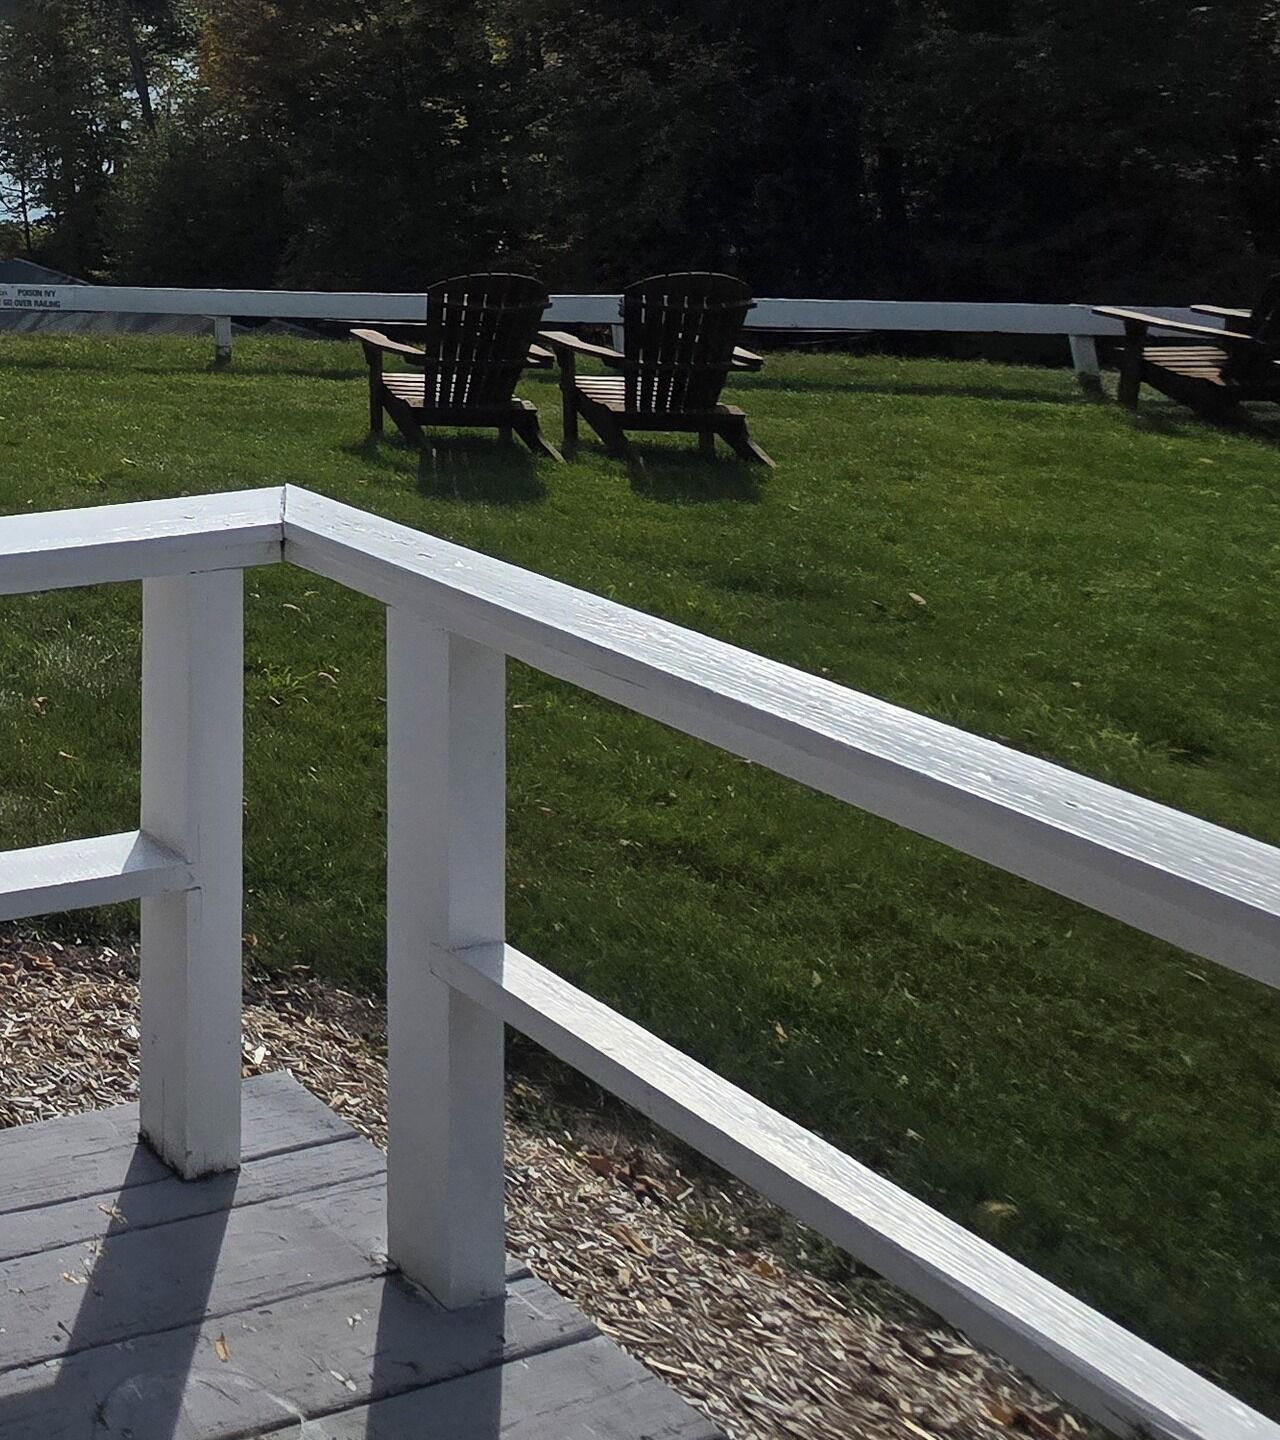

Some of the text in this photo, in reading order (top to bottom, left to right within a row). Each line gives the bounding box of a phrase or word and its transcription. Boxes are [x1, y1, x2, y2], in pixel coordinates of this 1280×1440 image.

[17, 288, 43, 297] POISON
[44, 289, 56, 297] IVY
[3, 298, 13, 306] GO
[14, 299, 32, 307] OVER
[33, 300, 61, 308] RAILING
